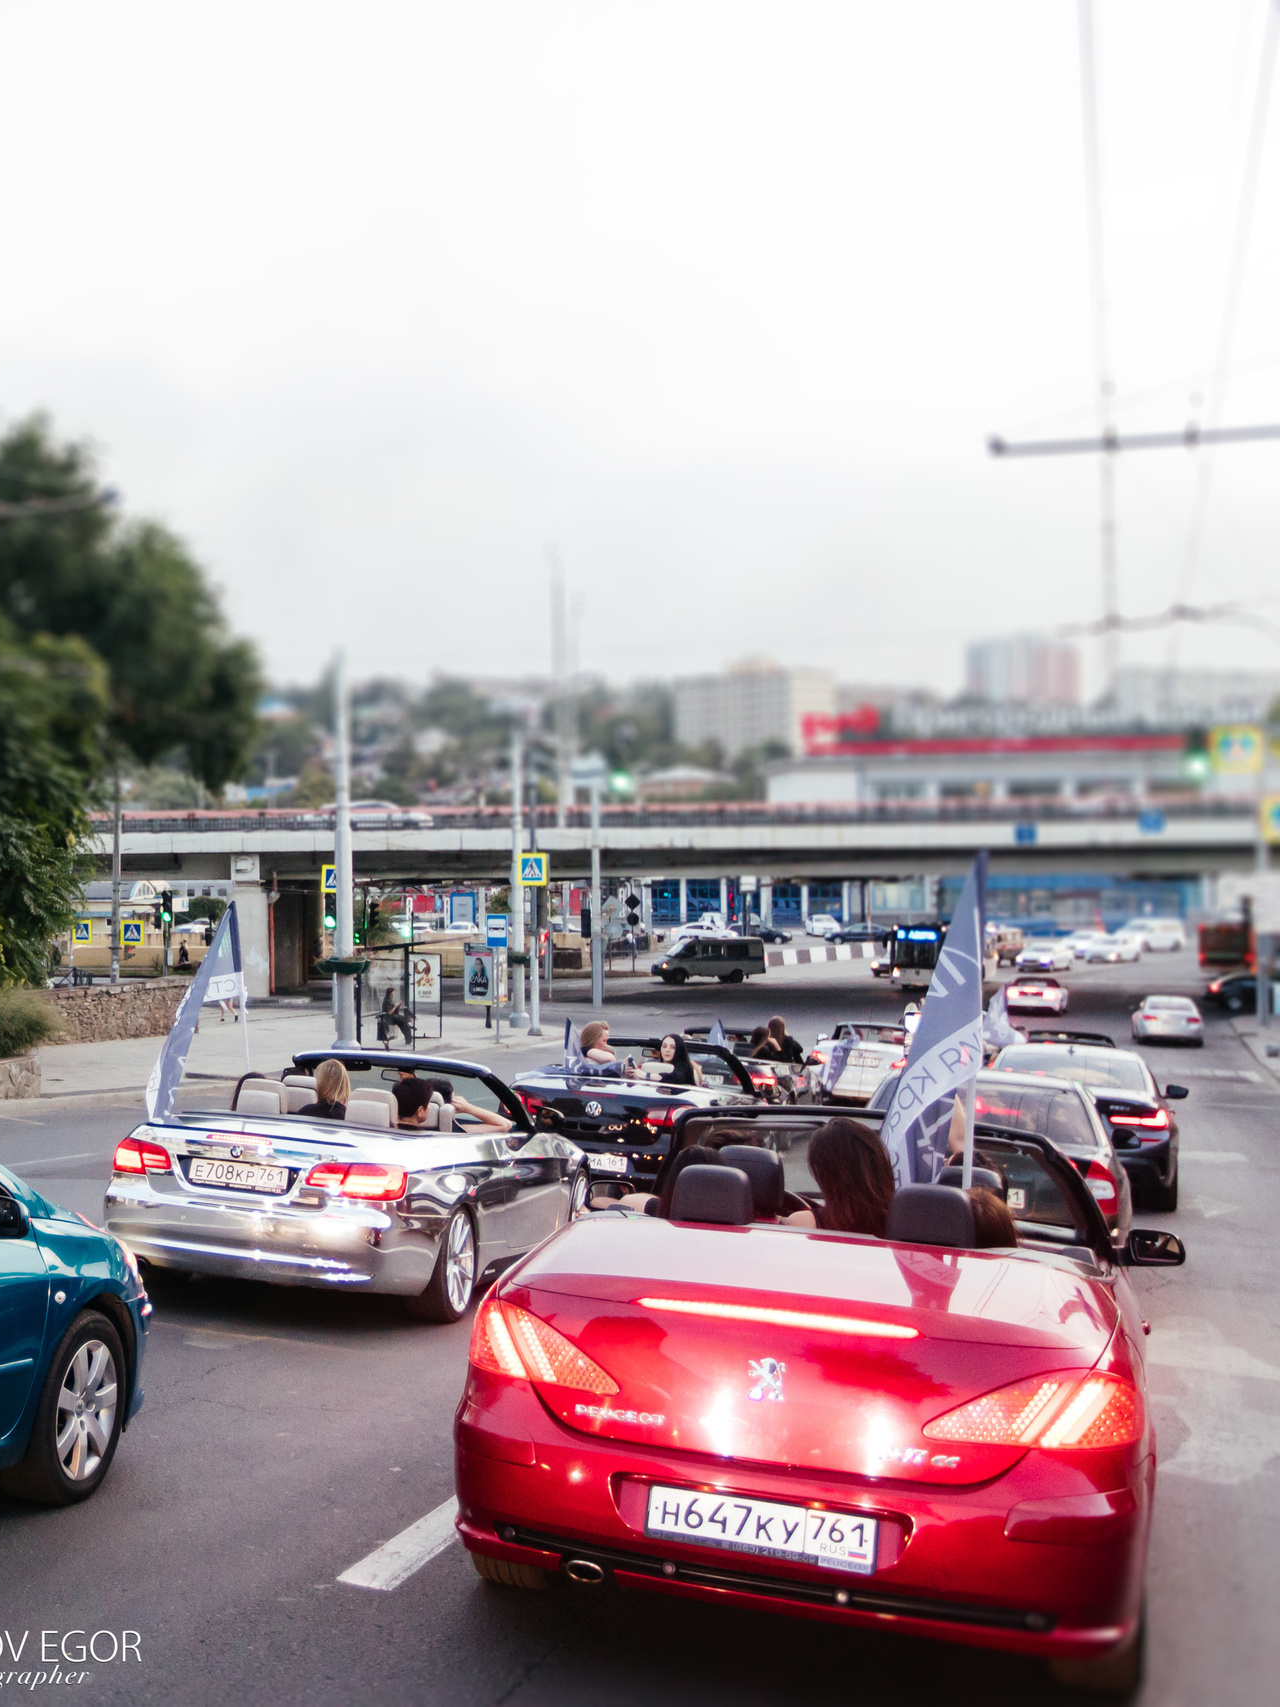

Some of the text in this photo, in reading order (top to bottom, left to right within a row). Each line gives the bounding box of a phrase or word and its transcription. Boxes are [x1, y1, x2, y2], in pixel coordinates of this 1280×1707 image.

[587, 1157, 602, 1167] МА
[259, 1168, 284, 1182] 761
[575, 1404, 665, 1425] PEUGEOT
[810, 1514, 866, 1548] 761
[820, 1542, 847, 1557] RUS
[820, 1557, 869, 1572] PEUGEOT
